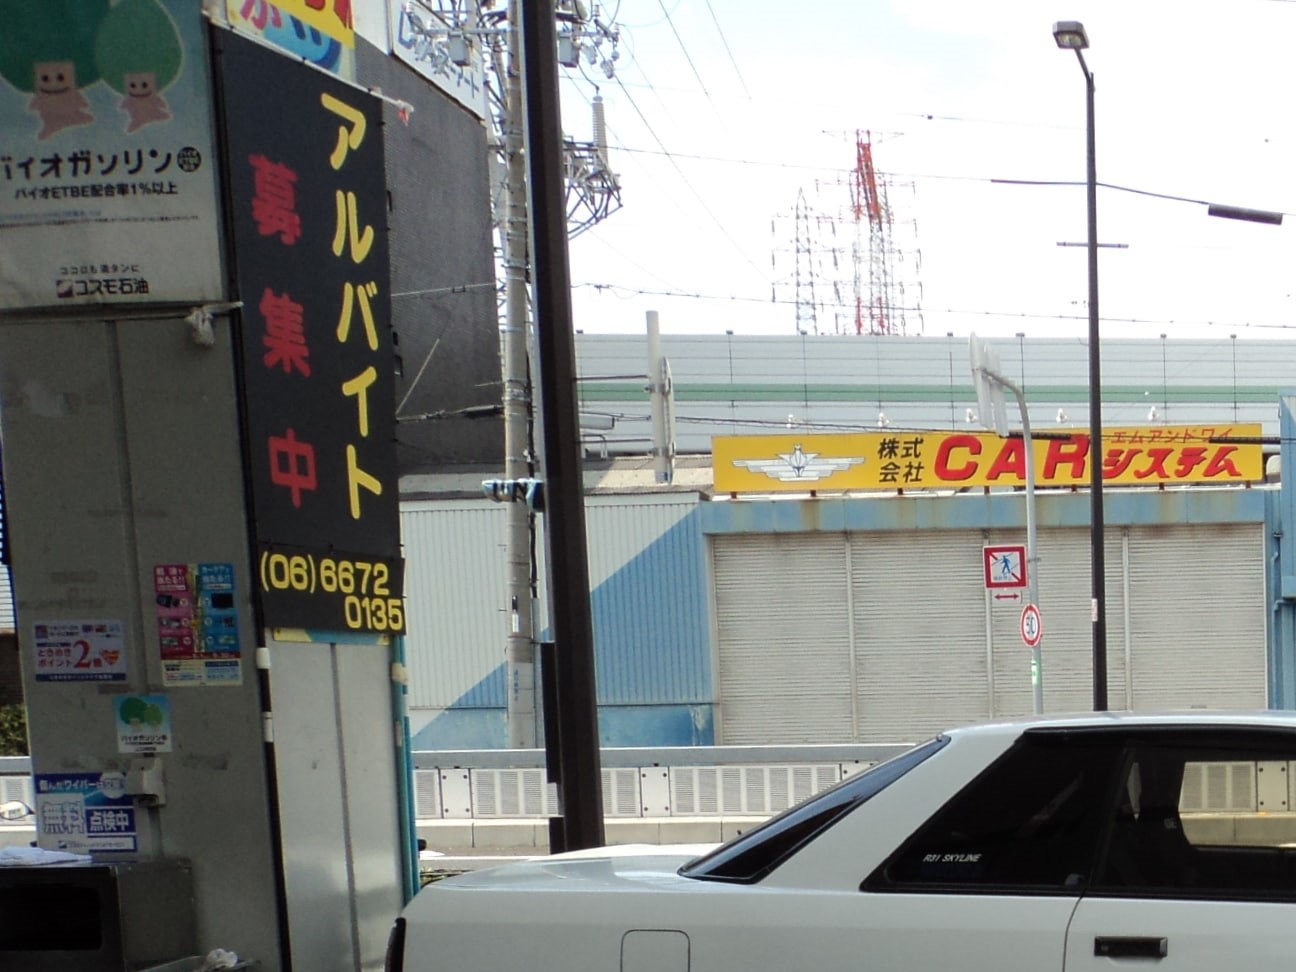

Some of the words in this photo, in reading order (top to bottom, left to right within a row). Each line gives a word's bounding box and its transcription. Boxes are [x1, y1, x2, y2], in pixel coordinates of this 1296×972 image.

[75, 277, 149, 296] コスモ石油
[321, 92, 382, 520] アルバイト
[248, 153, 318, 509] 募集中
[877, 437, 924, 459] 株式
[878, 462, 924, 483] 会社
[345, 596, 403, 630] 0135
[89, 810, 129, 832] 点検中
